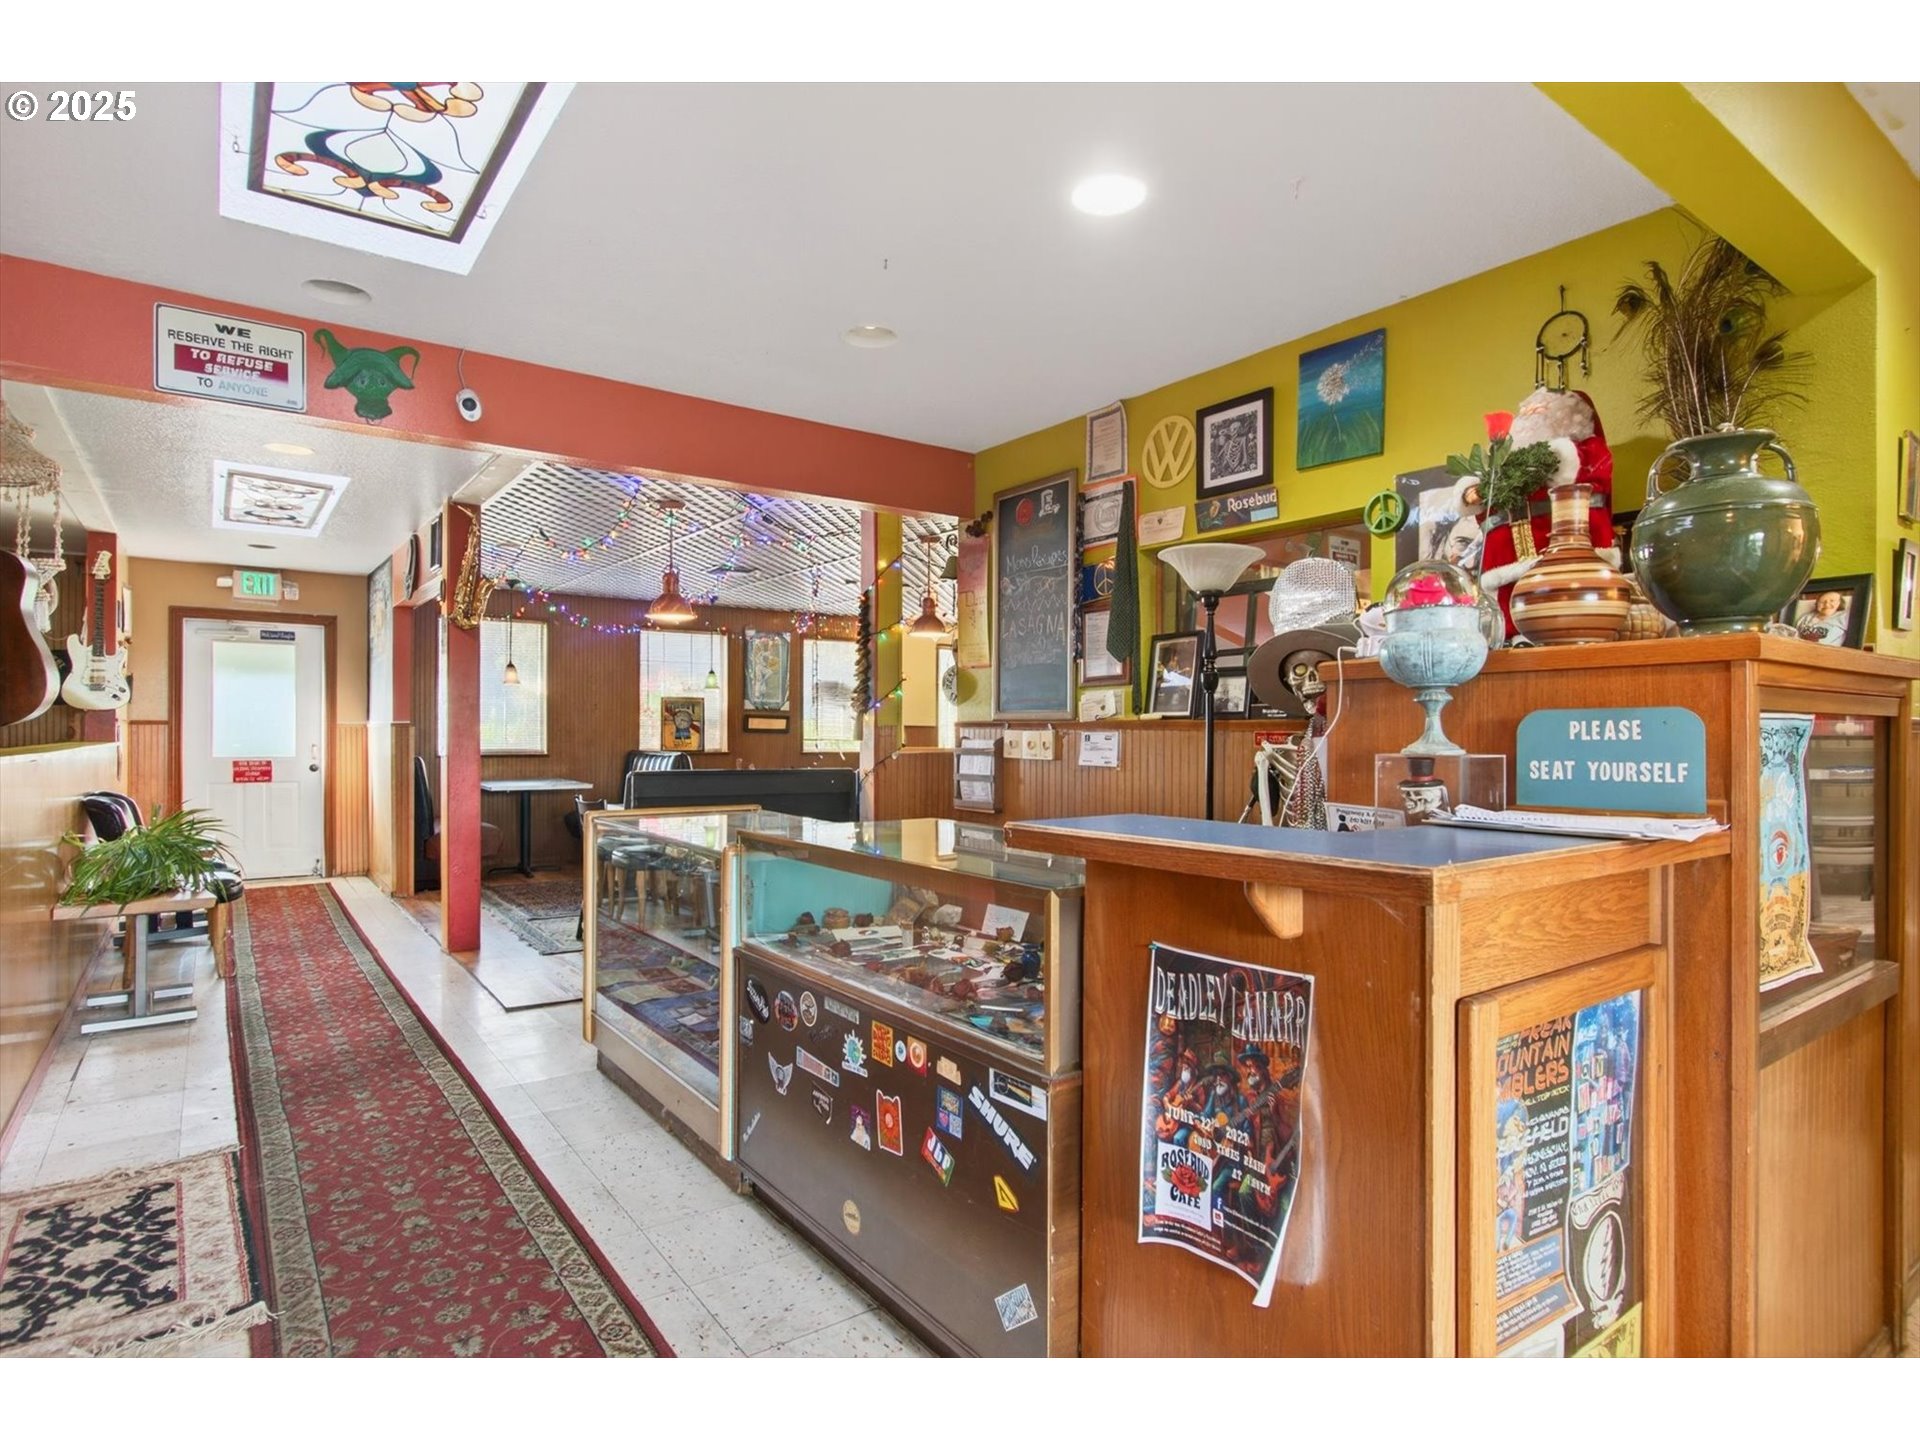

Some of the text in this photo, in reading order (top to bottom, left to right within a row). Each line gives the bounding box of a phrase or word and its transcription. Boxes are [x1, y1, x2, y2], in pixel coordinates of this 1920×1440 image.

[215, 323, 251, 339] WE
[167, 329, 293, 360] RESERVE THE RIGHT
[190, 348, 274, 372] TO REFUSE
[196, 376, 268, 397] TO ANYONE
[1227, 488, 1277, 513] Rosebud
[242, 571, 275, 595] EXIT
[1002, 611, 1066, 646] LASAGNA
[1569, 719, 1642, 741] PLEASE
[1529, 760, 1689, 783] SEAT YOURSELF
[1155, 966, 1228, 1028] DEADLEY
[968, 1085, 1034, 1171] SHURE
[1161, 1149, 1210, 1181] ROSEBUD
[1169, 1185, 1201, 1209] CAFE
